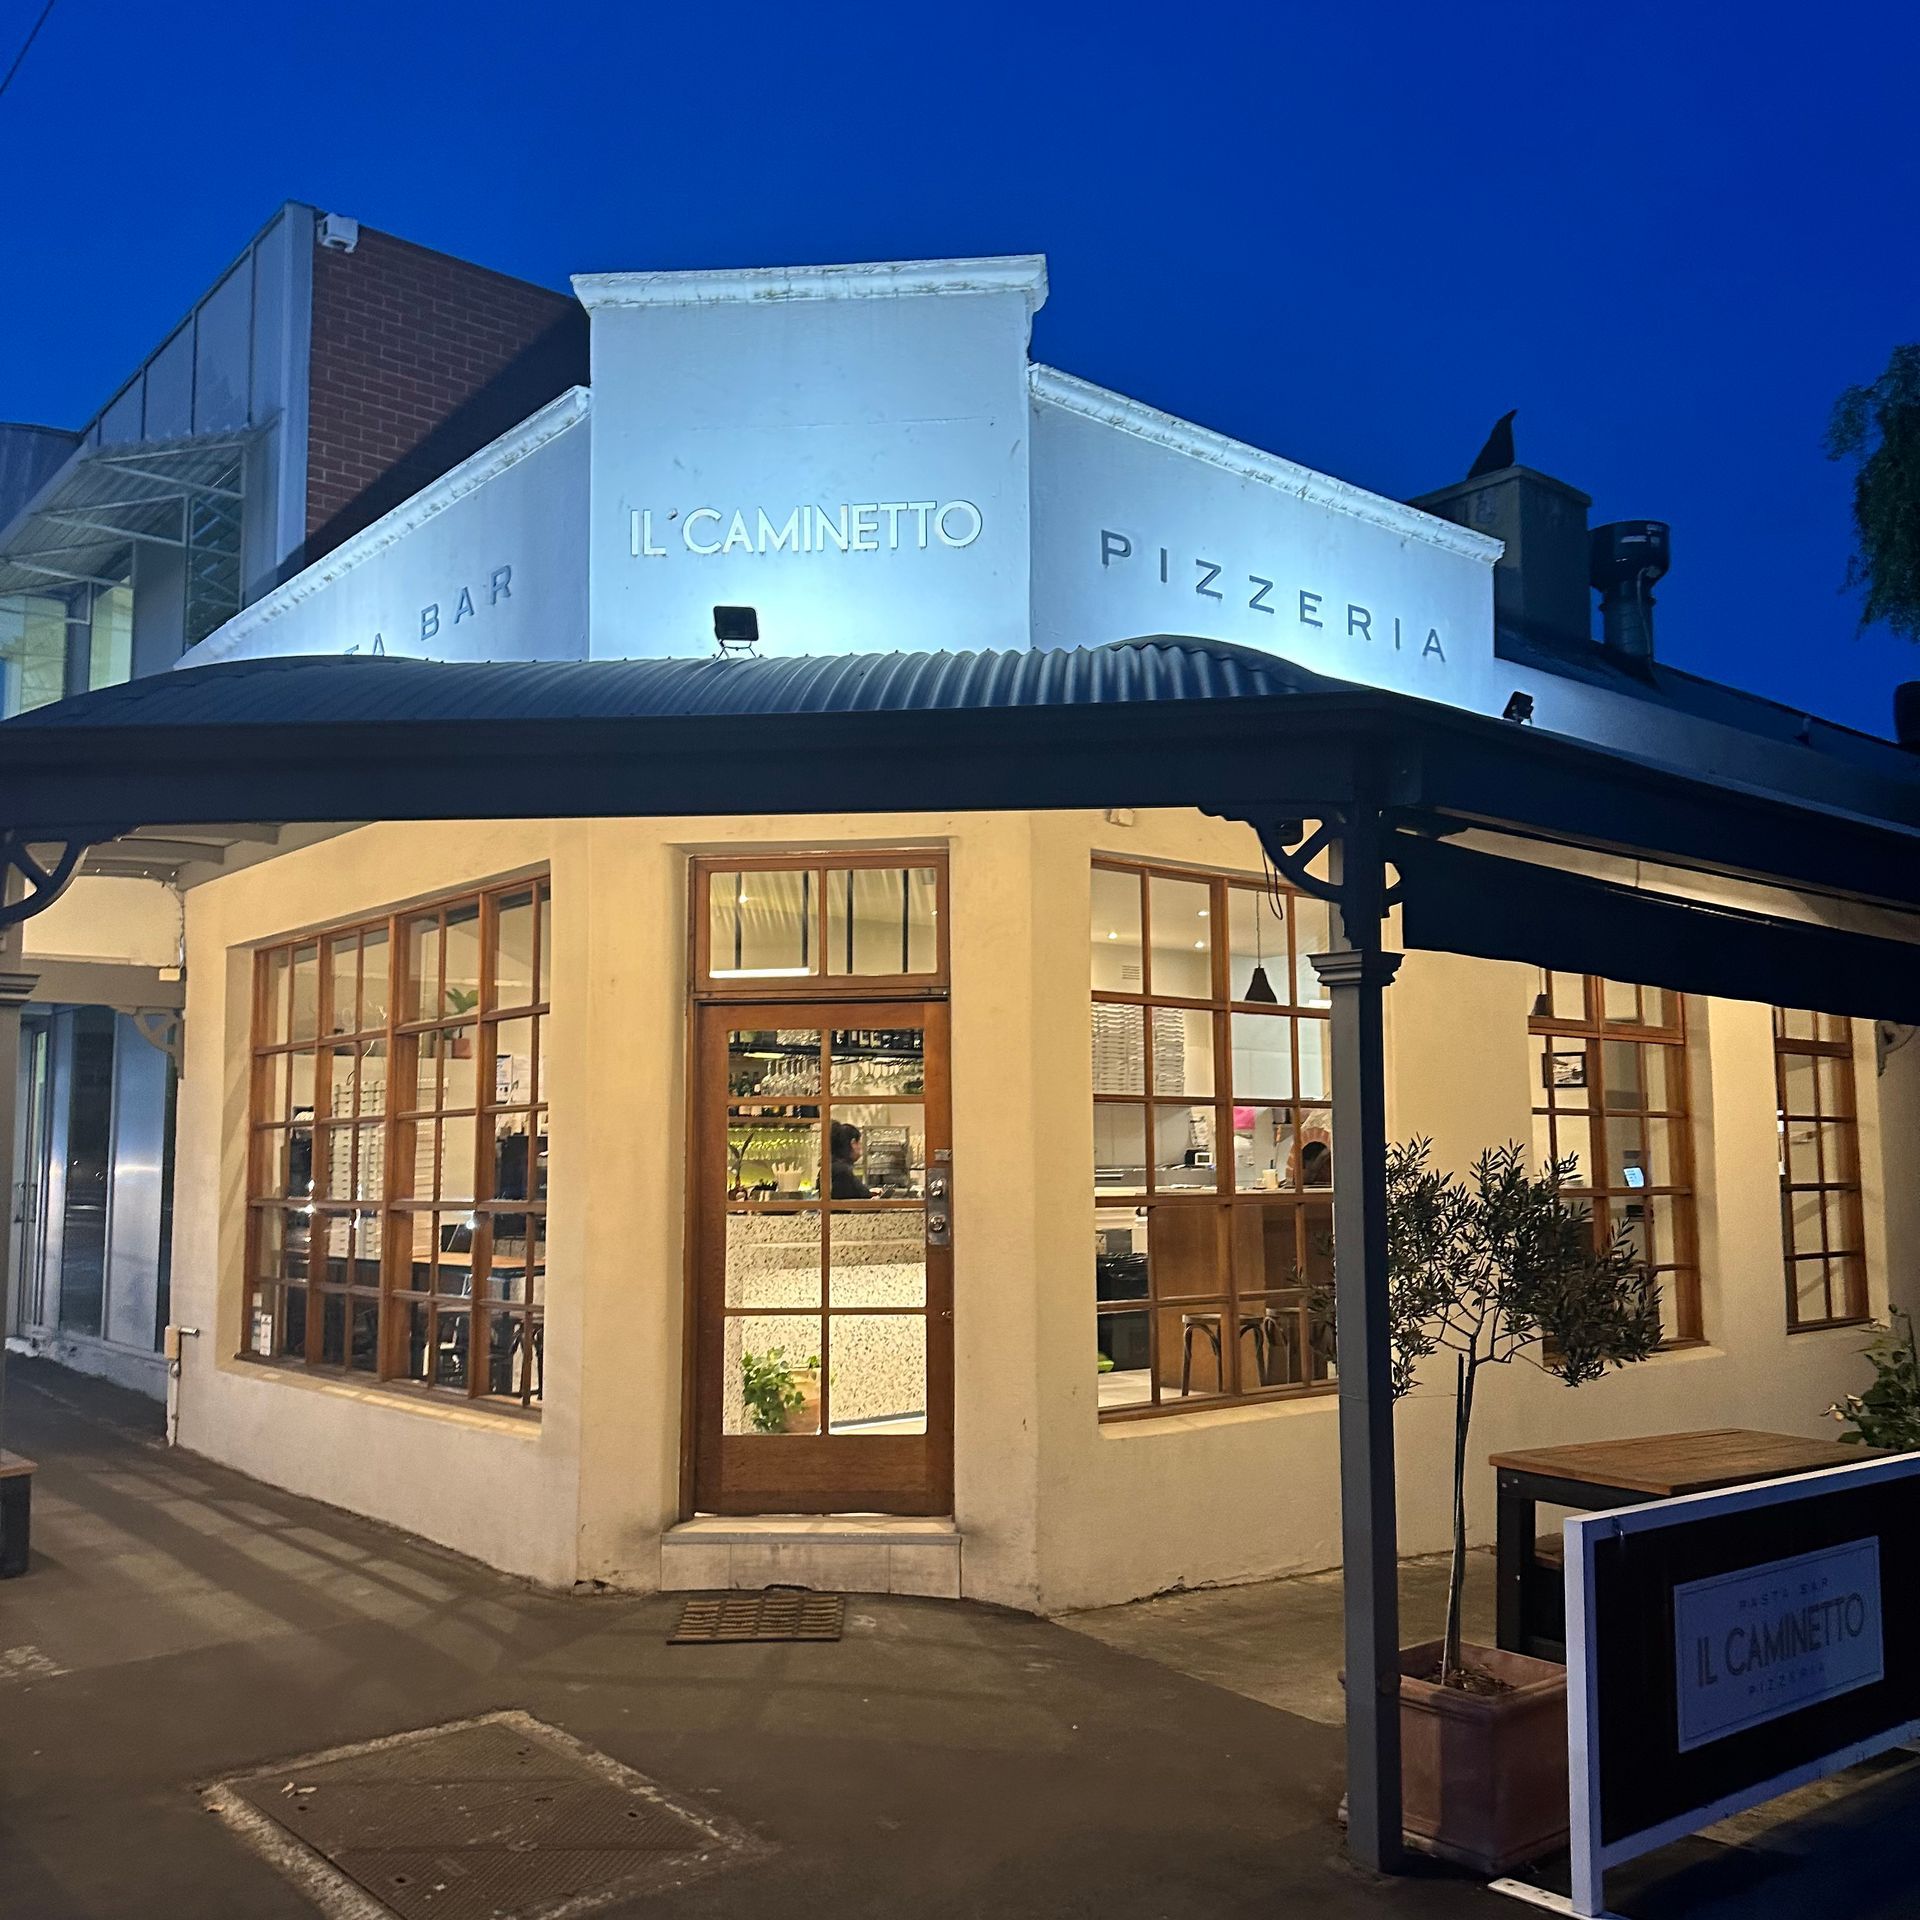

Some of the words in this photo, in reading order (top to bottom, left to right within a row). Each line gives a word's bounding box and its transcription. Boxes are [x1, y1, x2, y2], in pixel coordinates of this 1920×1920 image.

[630, 509, 667, 556] IL
[682, 499, 984, 555] CAMINETTO
[420, 564, 512, 642] BAR
[1100, 529, 1446, 663] PIZZERIA
[1697, 1636, 1718, 1687] IL
[1725, 1592, 1865, 1676] CAMINETTO
